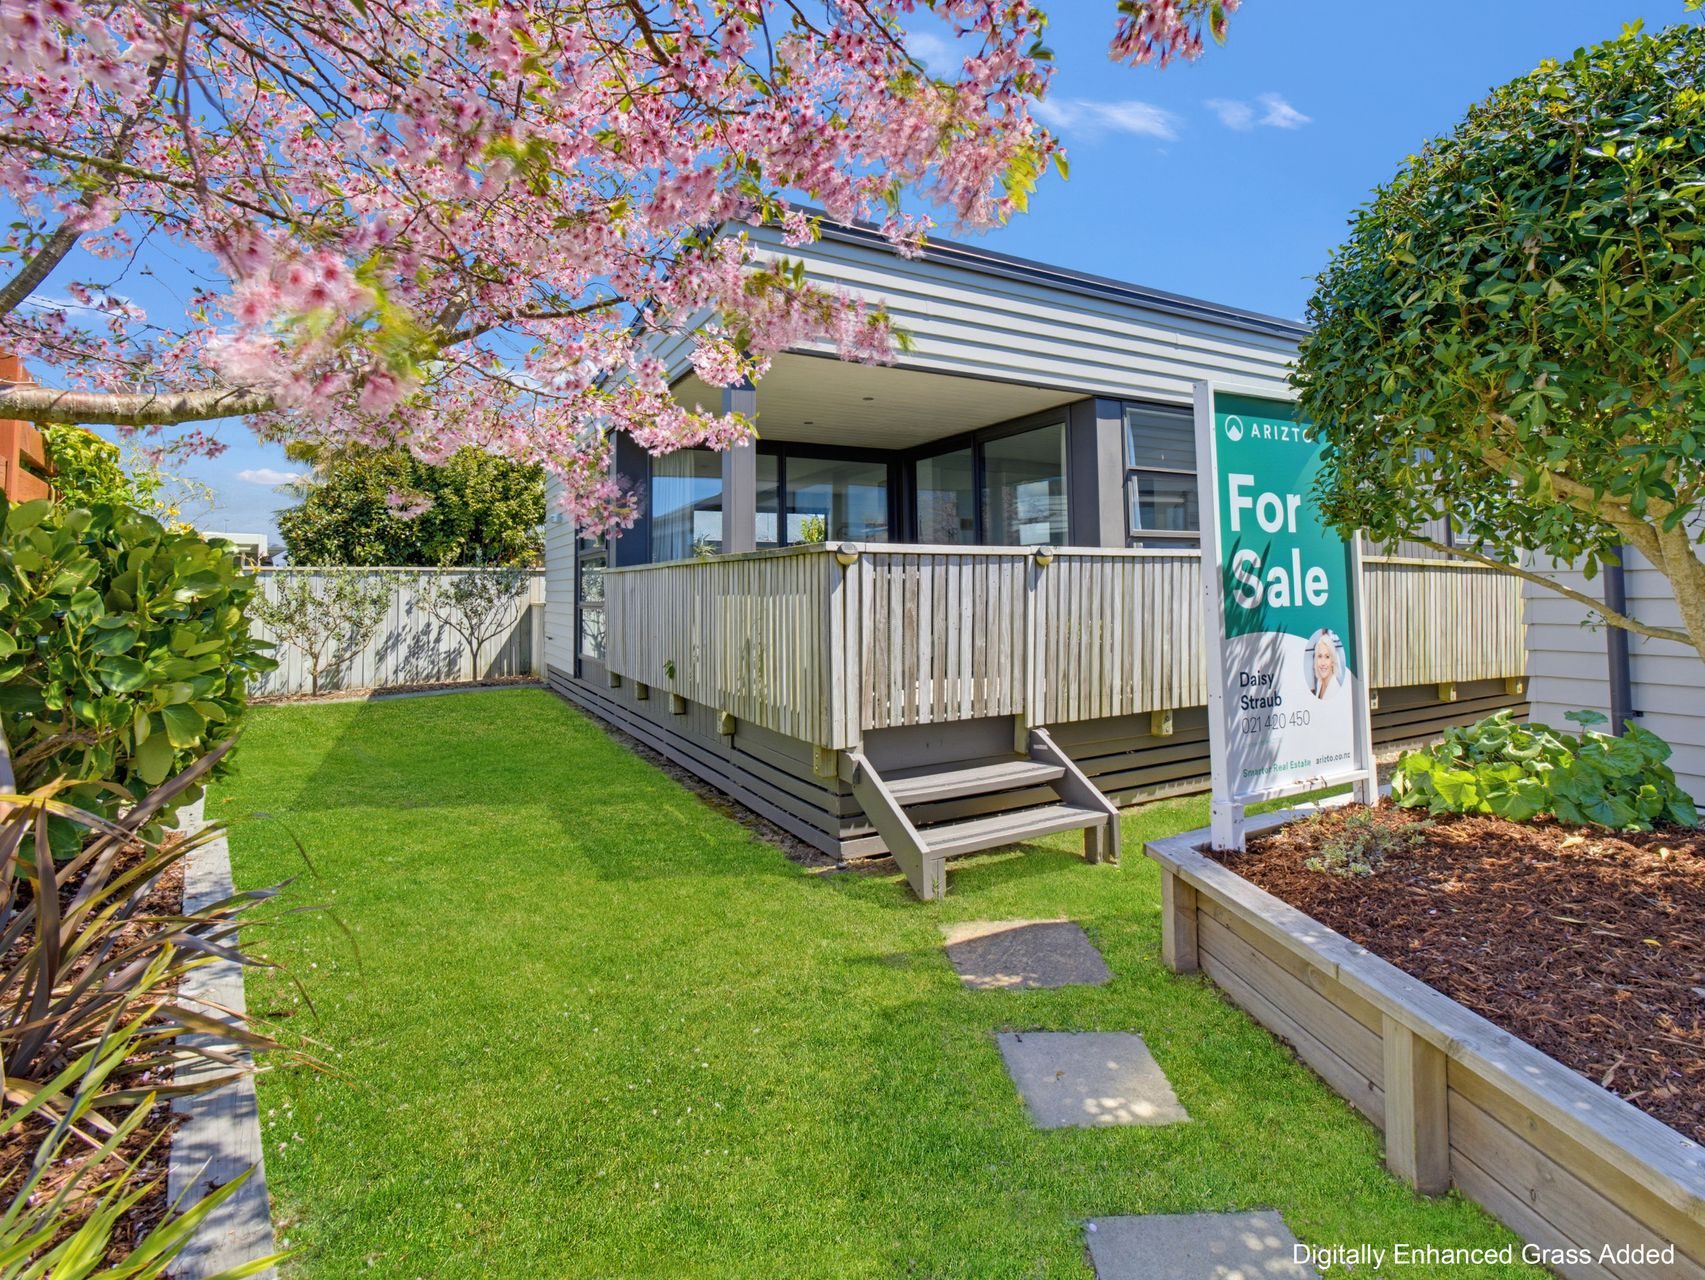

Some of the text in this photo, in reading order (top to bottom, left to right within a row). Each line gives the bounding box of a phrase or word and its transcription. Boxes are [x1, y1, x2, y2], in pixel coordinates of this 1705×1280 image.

[1228, 473, 1301, 533] For
[1232, 548, 1329, 609] Sale
[1240, 670, 1274, 689] Daisy
[1240, 691, 1282, 710] Straub
[1242, 709, 1310, 734] 021 420 450
[1273, 762, 1289, 772] Real
[1290, 758, 1311, 769] Estate
